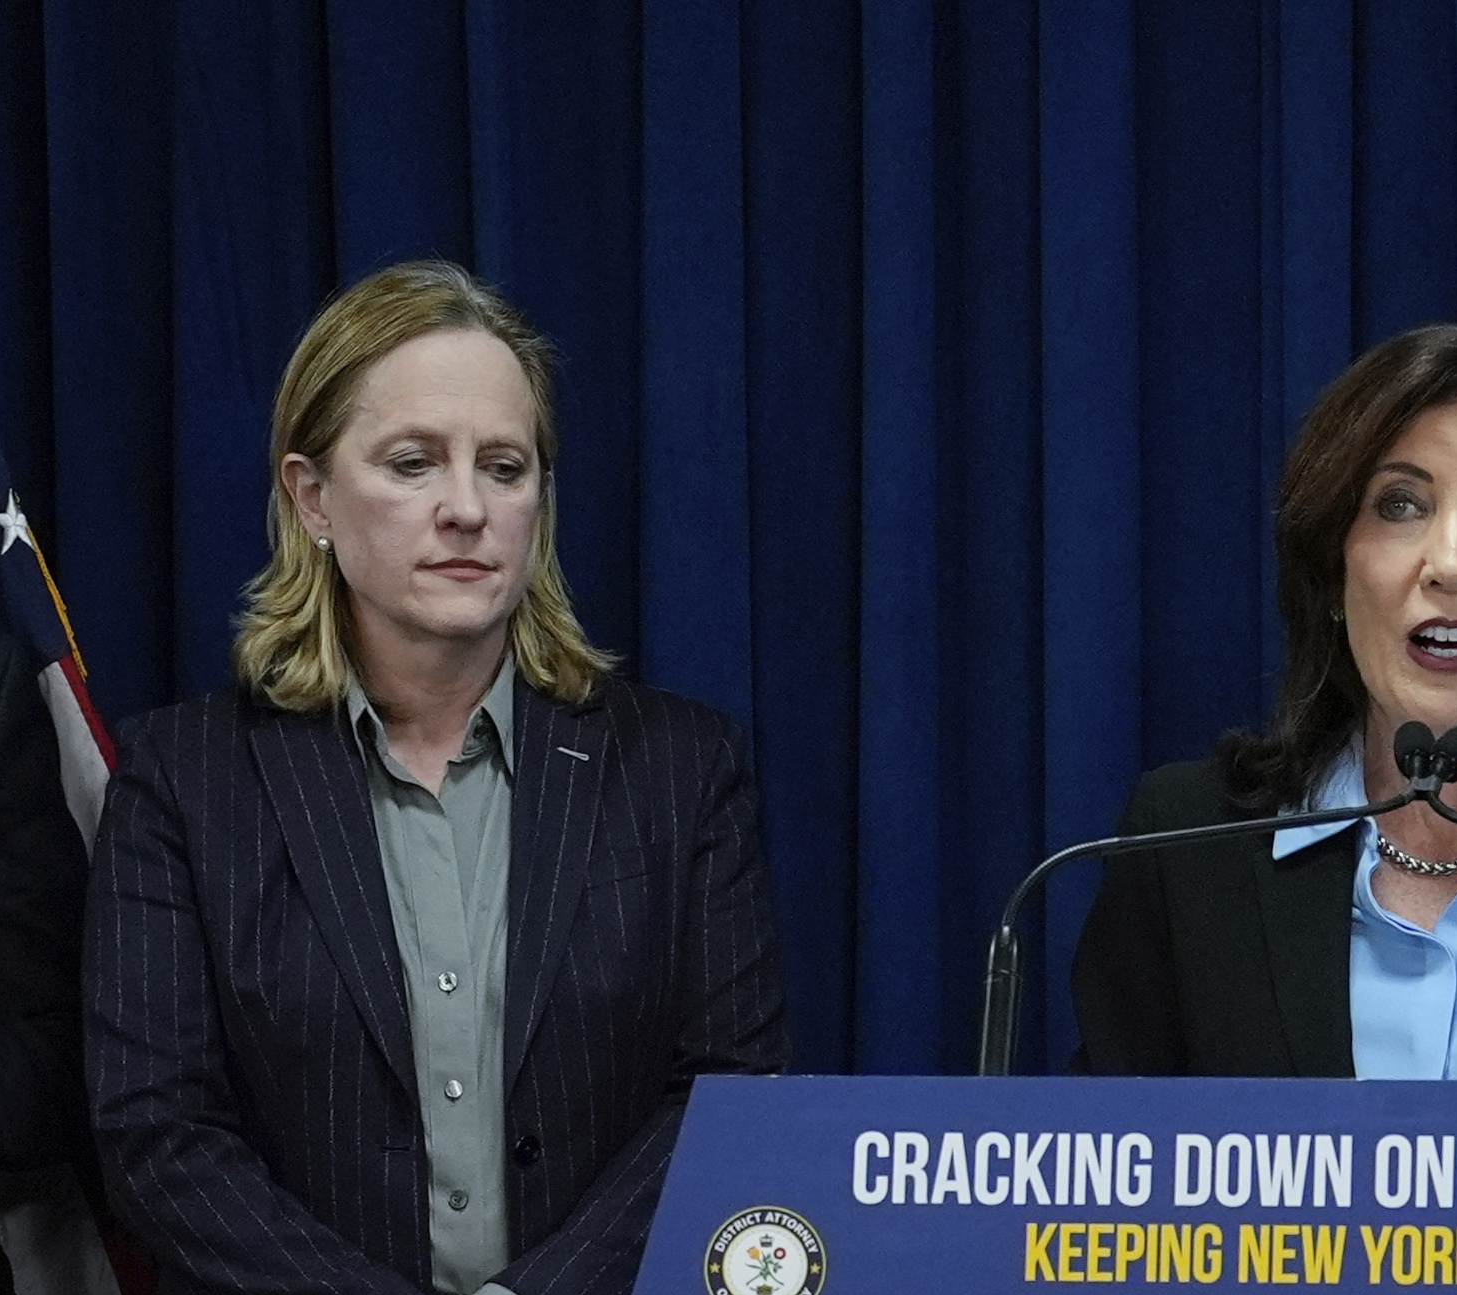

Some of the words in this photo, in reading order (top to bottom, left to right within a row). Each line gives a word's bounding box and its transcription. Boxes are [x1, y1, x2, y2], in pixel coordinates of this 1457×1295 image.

[852, 1130, 1153, 1206] CRACKING
[1174, 1133, 1354, 1208] DOWN
[1375, 1134, 1455, 1209] ON
[714, 1212, 762, 1253] DISTRICT
[764, 1212, 819, 1253] ATTORNEY
[1024, 1222, 1223, 1284] KEEPING
[1238, 1224, 1347, 1285] NEW
